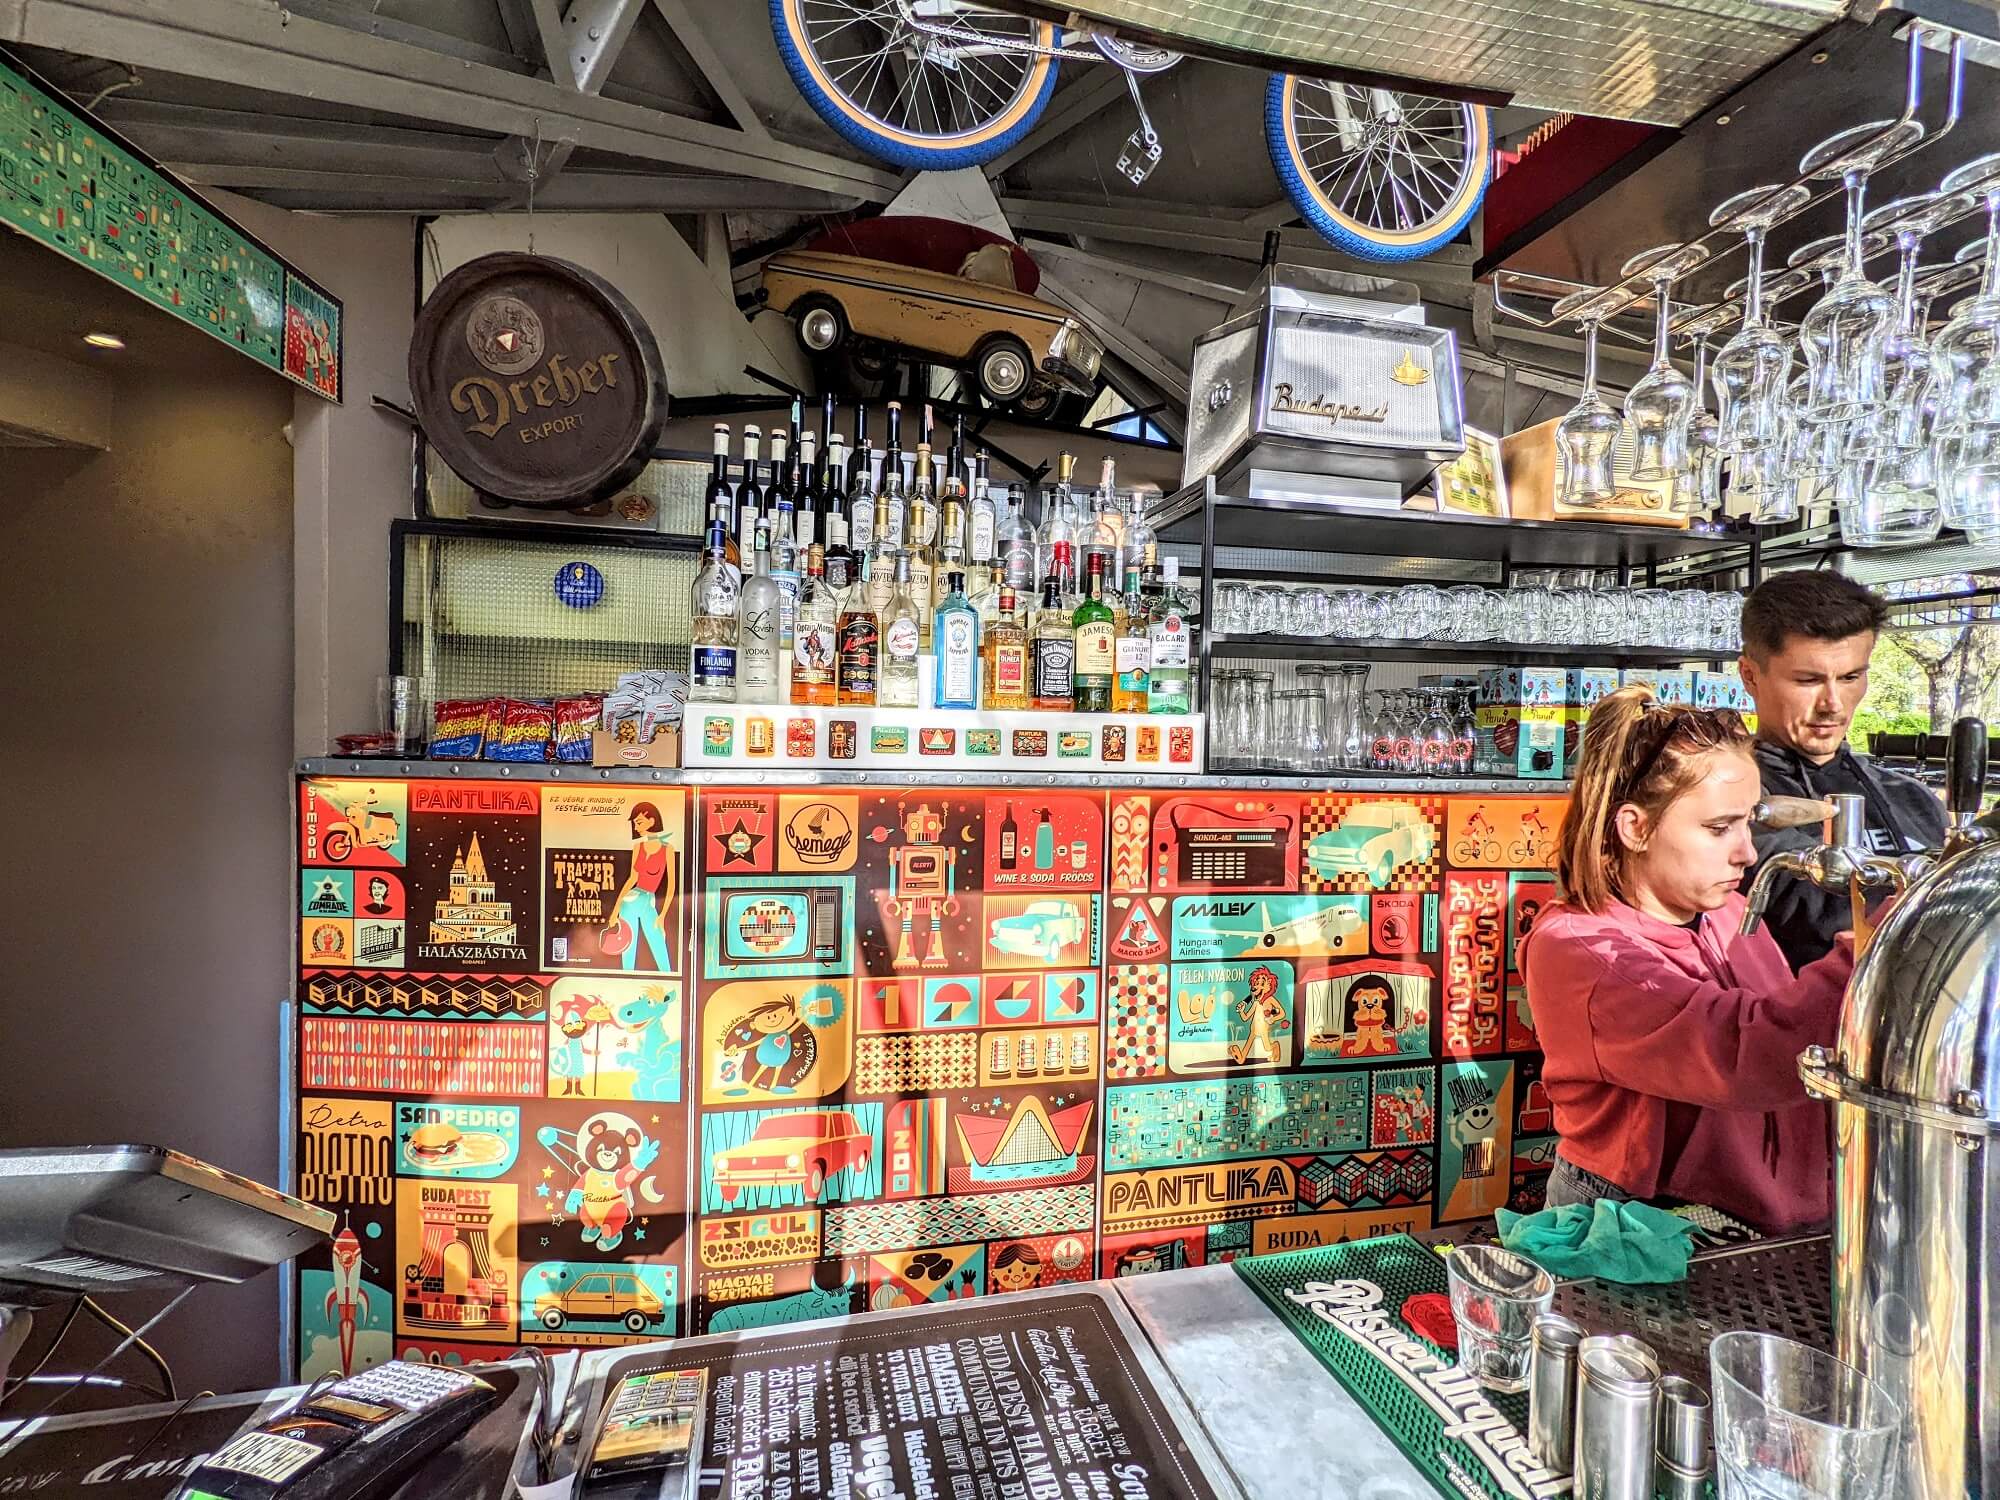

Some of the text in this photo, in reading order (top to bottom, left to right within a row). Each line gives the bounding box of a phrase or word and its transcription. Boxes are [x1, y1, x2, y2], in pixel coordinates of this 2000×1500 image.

[451, 353, 619, 440] Dreher
[1271, 383, 1389, 424] Budapest
[519, 414, 585, 443] EXPORT
[796, 623, 816, 632] Captain
[700, 656, 732, 667] FINLANDIA
[745, 648, 770, 656] VODKA
[553, 861, 615, 891] TRAPPER
[994, 870, 1095, 883] WINE & SODA FRÖCCS
[307, 900, 349, 913] COMRADE
[566, 899, 602, 916] FARMER
[418, 943, 528, 960] HALÁSZBÁSTYA
[1145, 944, 1161, 955] SAJT
[1179, 938, 1223, 949] Hungarian
[1179, 948, 1211, 956] Airlines
[306, 1103, 387, 1129] Retro
[301, 1131, 393, 1206] BISTRO
[1464, 1171, 1494, 1179] BUDAPEST
[704, 1215, 816, 1241] ZSIGULI
[1268, 1221, 1415, 1249] BUDA PEST
[708, 1273, 775, 1290] MAGYAR
[708, 1284, 775, 1303] SZÜRKE
[534, 1335, 603, 1344] POLSKI
[768, 1368, 794, 1388] 265
[796, 1364, 816, 1372] 2
[797, 1372, 817, 1384] db
[925, 1343, 970, 1415] ZOMBIES
[887, 1349, 919, 1422] TO YOUR BODY
[908, 1347, 937, 1418] PREFER OUR MEAT
[1284, 1277, 1440, 1374] Pilsner
[1423, 1365, 1573, 1500] Urquell
[956, 1338, 1019, 1478] COMMUNISM IN ITS
[978, 1333, 1064, 1500] BUDAPEST HAMB
[1057, 1409, 1075, 1430] YOU
[1073, 1406, 1114, 1459] REGRET
[771, 1450, 790, 1473] AZ
[799, 1448, 821, 1493] AMIT
[854, 1434, 906, 1500] vege
[904, 1429, 940, 1500] Húsételei
